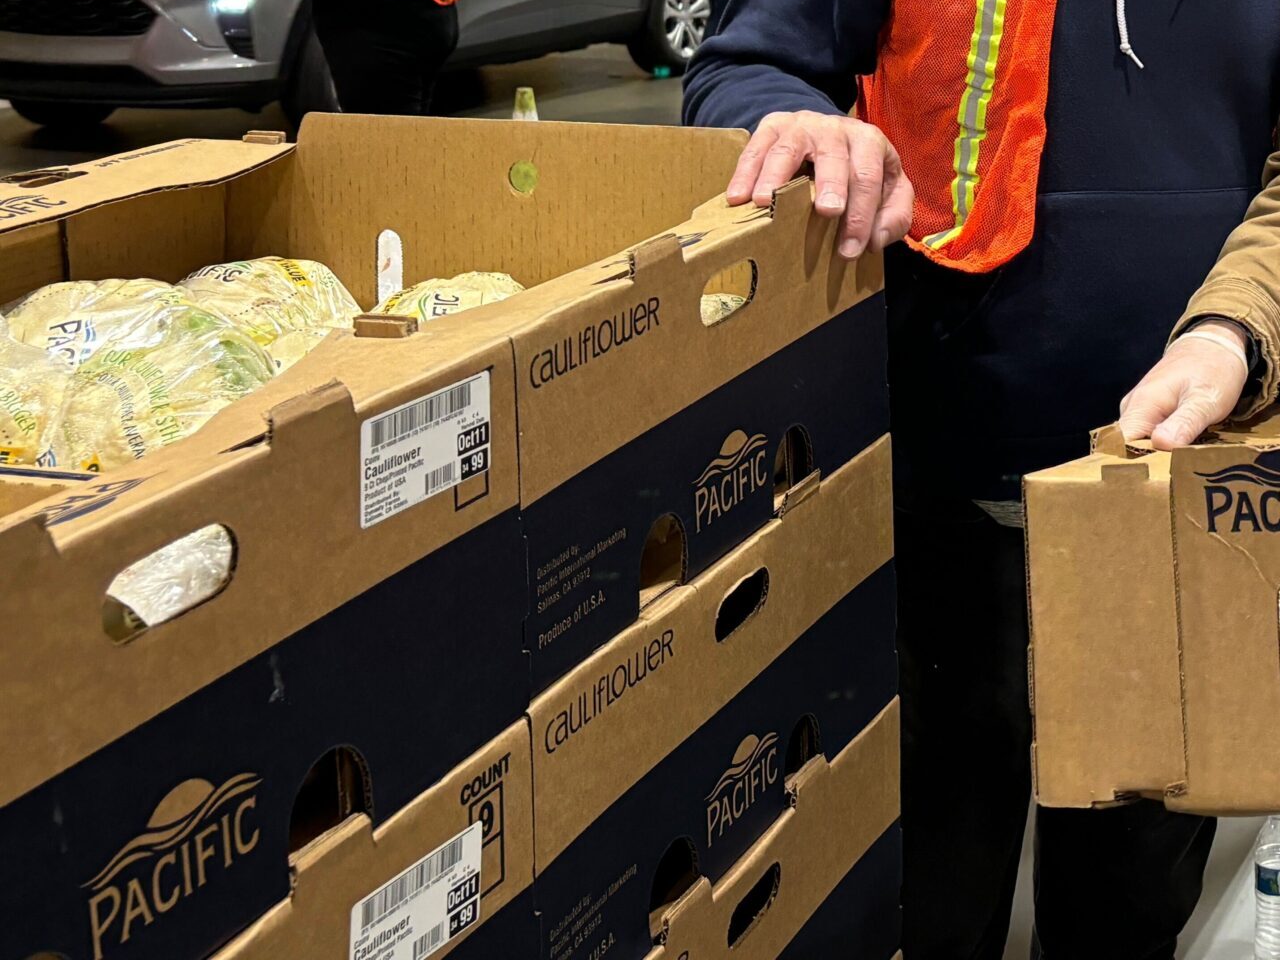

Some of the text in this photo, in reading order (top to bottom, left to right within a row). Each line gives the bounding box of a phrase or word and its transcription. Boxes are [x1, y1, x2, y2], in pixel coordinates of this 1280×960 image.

[458, 425, 485, 451] Oct11
[365, 446, 421, 480] Cauliflower
[471, 452, 484, 471] 99
[364, 487, 387, 502] Product
[394, 477, 406, 488] USA
[695, 450, 767, 534] PACIFIC
[537, 575, 558, 597] Pacific
[597, 527, 626, 554] Marketing
[562, 581, 571, 595] CA
[538, 590, 606, 649] Produce of U.S.A.
[460, 751, 512, 807] COUNT
[706, 746, 778, 848] PACIFIC
[479, 799, 494, 836] 9
[88, 794, 260, 960] PACIFIC
[448, 876, 476, 909] Oct11
[460, 906, 473, 927] 99
[354, 915, 411, 960] Cauliflower
